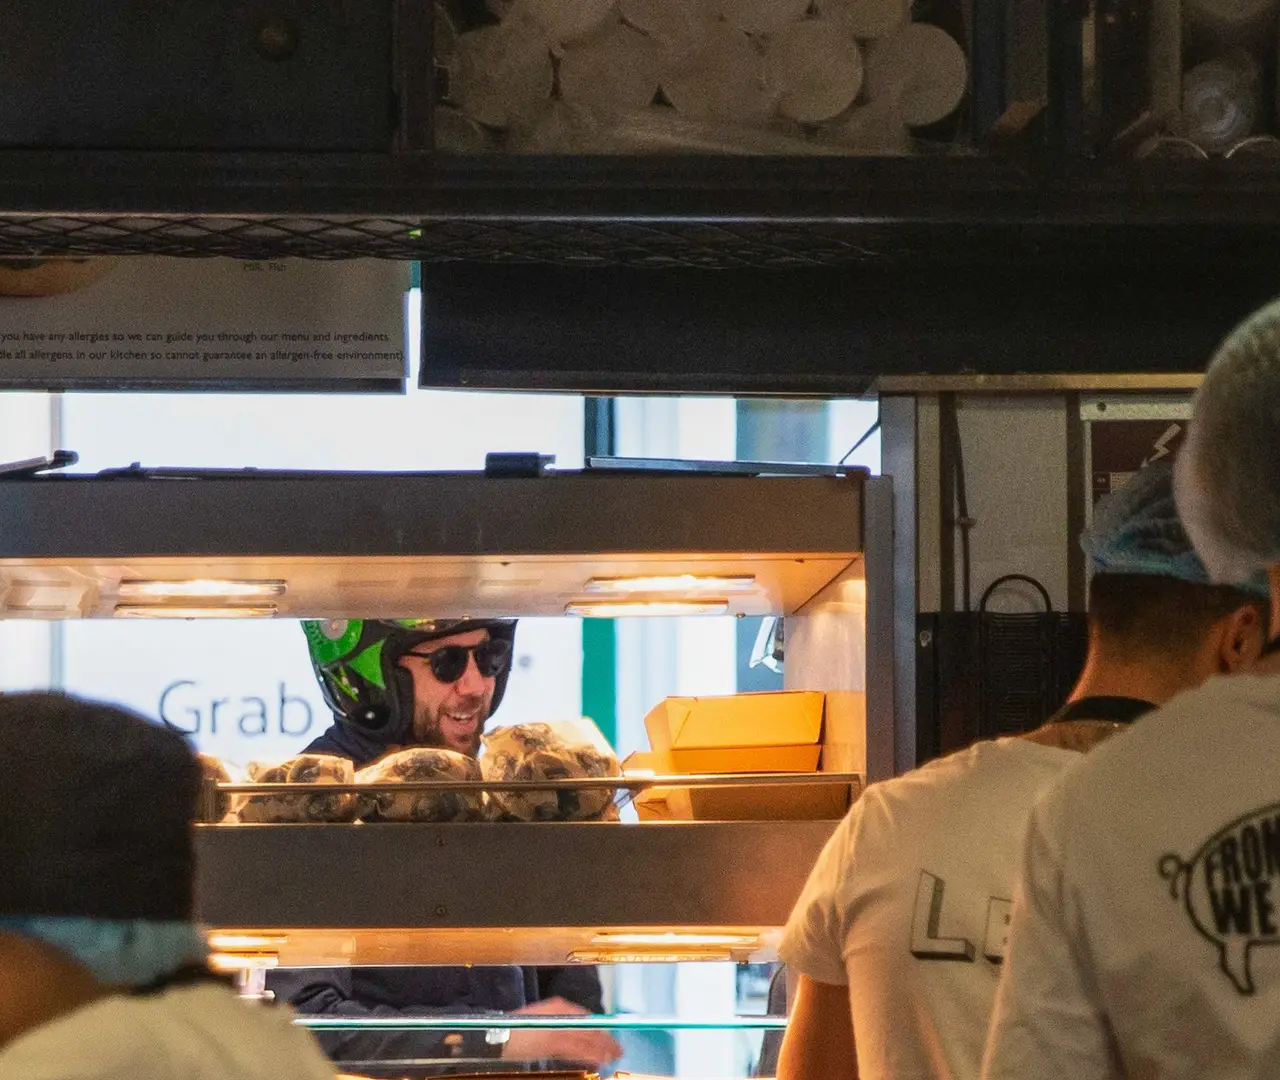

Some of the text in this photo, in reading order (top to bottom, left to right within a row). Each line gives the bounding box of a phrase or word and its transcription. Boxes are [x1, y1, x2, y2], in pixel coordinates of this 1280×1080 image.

[1, 332, 20, 344] you
[23, 331, 45, 342] have
[49, 333, 66, 344] any
[68, 331, 110, 344] allergies
[112, 333, 125, 342] so
[128, 333, 143, 342] we
[146, 333, 163, 342] can
[166, 332, 193, 344] guide
[196, 334, 214, 345] you
[217, 332, 258, 345] through
[260, 334, 278, 343] our
[282, 334, 310, 343] menu
[313, 332, 331, 343] and
[14, 349, 27, 360] all
[29, 349, 73, 363] allergens
[76, 349, 86, 360] in
[88, 351, 108, 360] our
[110, 349, 148, 360] kitchen
[150, 351, 163, 360] so
[165, 350, 199, 360] cannot
[202, 350, 252, 363] guarantee
[255, 351, 267, 360] an
[270, 349, 333, 363] allergen-free
[157, 679, 314, 737] Grab
[1207, 880, 1278, 936] WE
